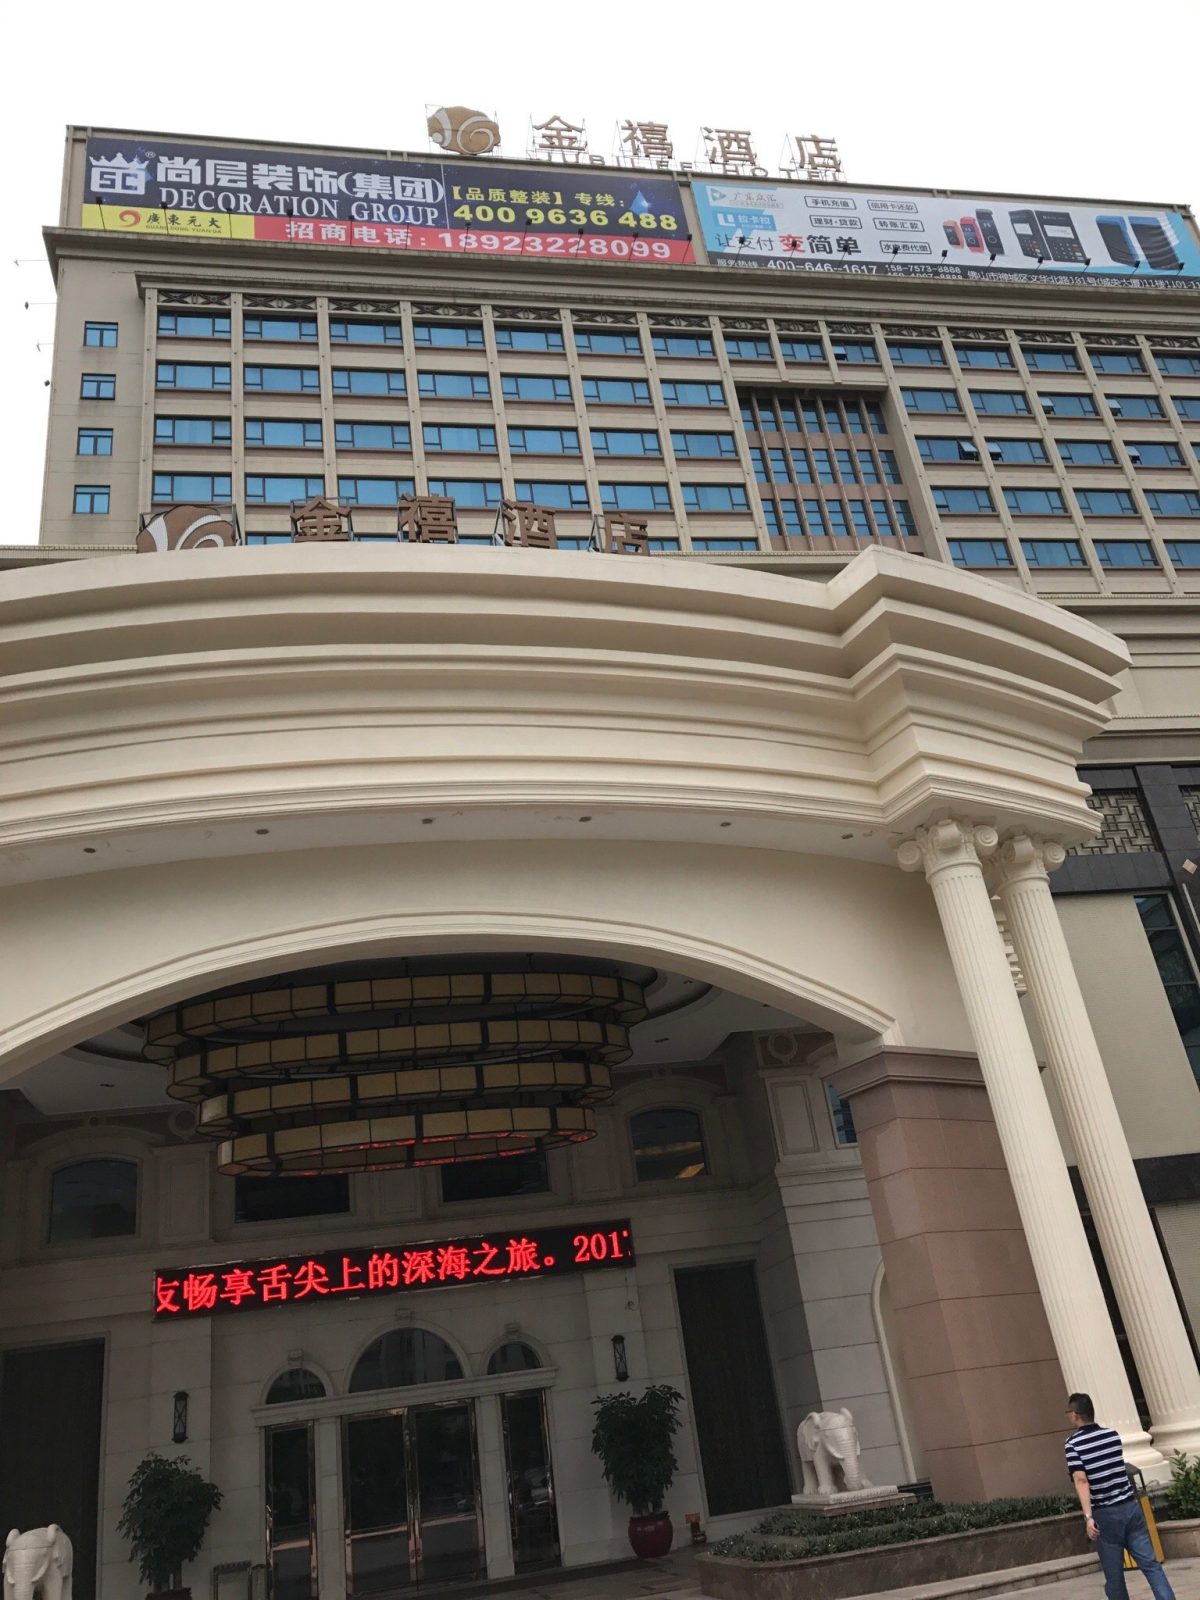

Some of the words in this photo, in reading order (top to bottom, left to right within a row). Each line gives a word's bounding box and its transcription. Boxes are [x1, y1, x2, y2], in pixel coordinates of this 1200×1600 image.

[532, 114, 842, 173] 金禧酒店
[722, 163, 848, 183] HOTEL
[159, 187, 339, 219] DECORATION
[350, 201, 439, 227] GROUP
[453, 204, 516, 223] 400
[525, 208, 610, 226] 9636
[617, 211, 678, 231] 488
[811, 199, 850, 208] 手机充值
[290, 491, 650, 557] 金禧酒店
